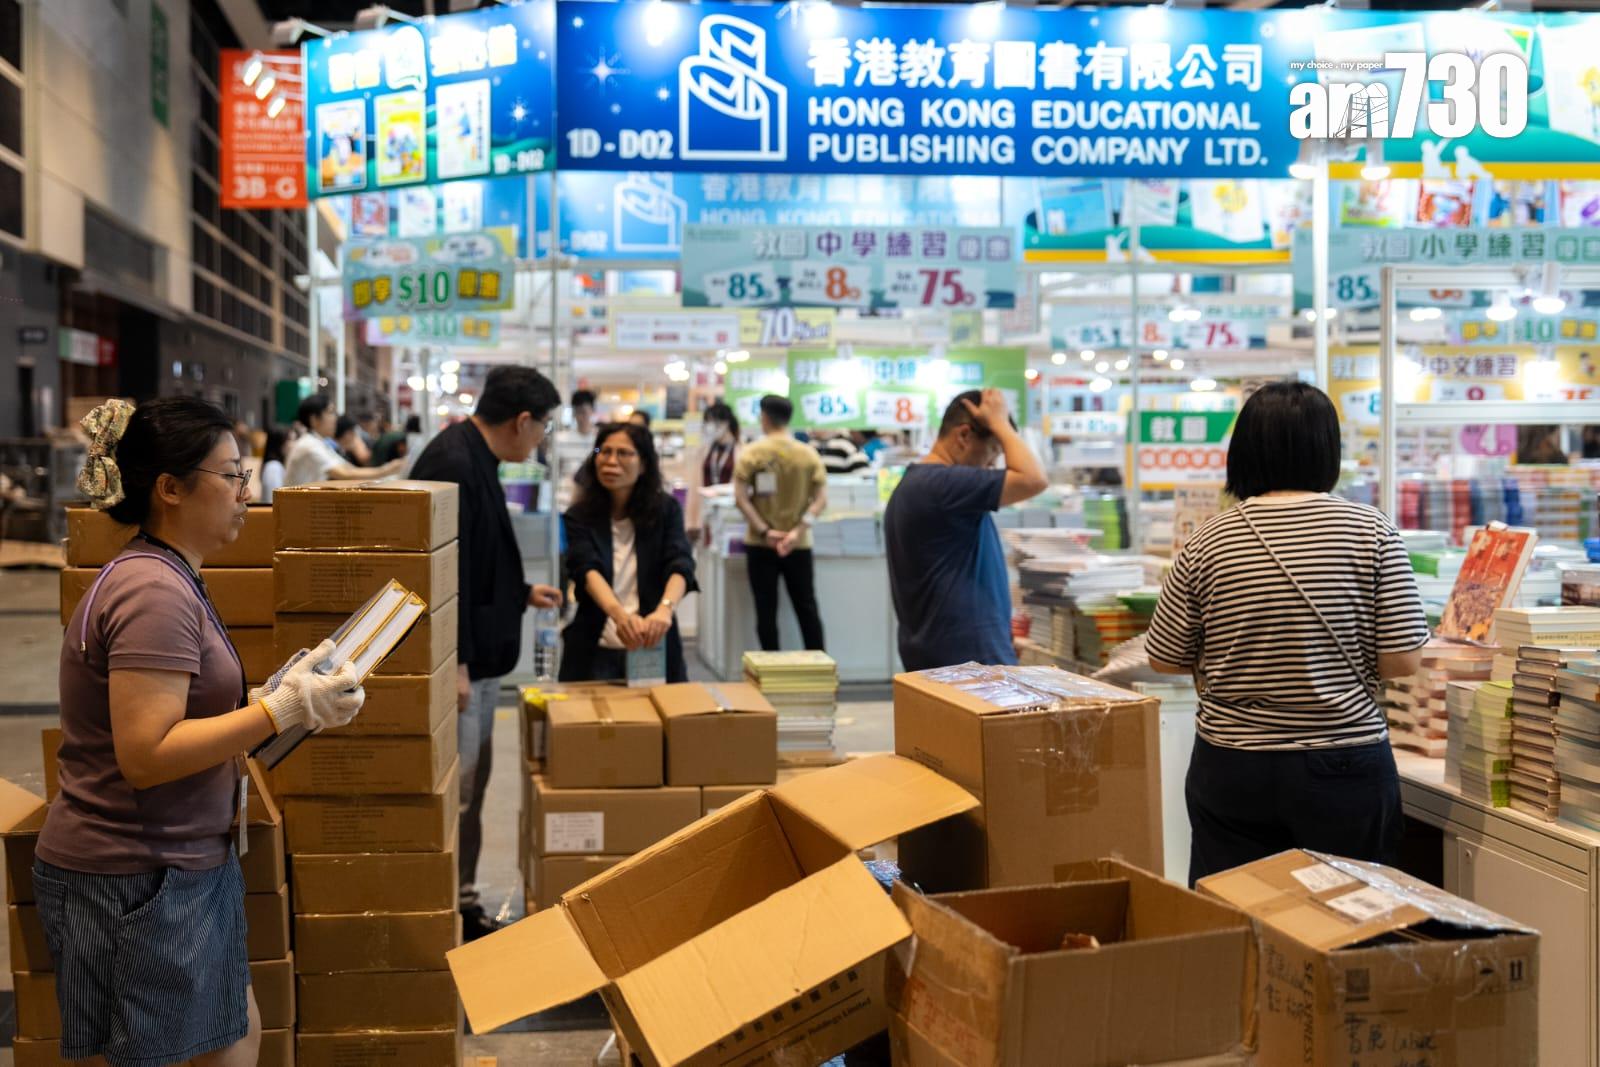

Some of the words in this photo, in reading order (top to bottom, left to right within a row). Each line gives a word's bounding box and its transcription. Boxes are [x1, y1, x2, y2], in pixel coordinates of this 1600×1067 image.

[807, 39, 1263, 92] 香港教育圖書有限公司
[807, 97, 906, 129] HONG
[922, 98, 1016, 129] KONG
[1031, 99, 1259, 131] EDUCATIONAL
[807, 133, 1016, 165] PUBLISHING
[1030, 136, 1189, 166] COMPANY
[1203, 137, 1268, 166] LTD.
